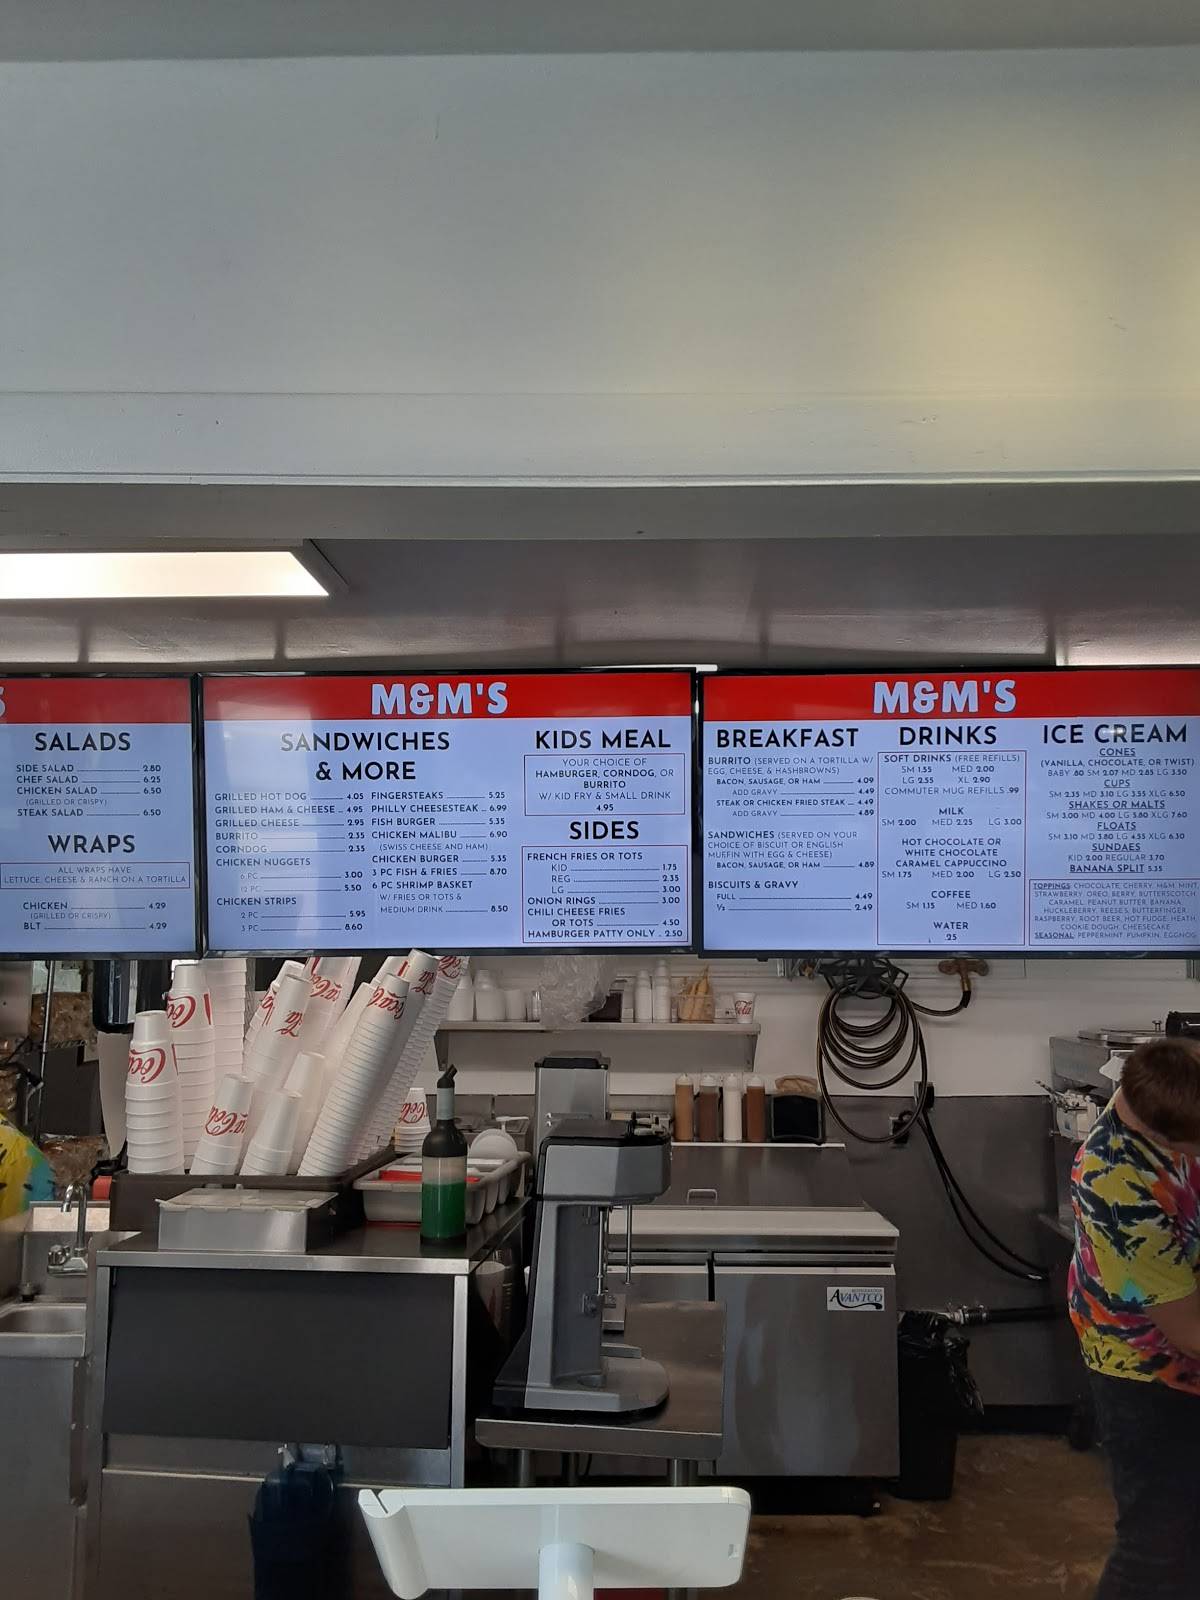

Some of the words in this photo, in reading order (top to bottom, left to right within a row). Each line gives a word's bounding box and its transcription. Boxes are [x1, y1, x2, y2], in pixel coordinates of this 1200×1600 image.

[371, 682, 508, 715] M&M'S
[873, 680, 1017, 714] M&M'S
[717, 728, 859, 748] BREAKFAST
[899, 726, 997, 745] DRINKS
[1043, 724, 1084, 744] ICE
[1094, 724, 1187, 743] CREAM
[34, 732, 131, 751] SALADS
[280, 732, 450, 752] SANDWICHES
[536, 730, 592, 749] KIDS
[602, 729, 671, 748] MEAL
[1099, 748, 1136, 756] CONES
[563, 758, 590, 767] YOUR
[592, 758, 630, 766] CHOICE
[633, 758, 647, 766] OF
[884, 755, 910, 763] SOFT
[16, 764, 38, 773] SIDE
[42, 764, 74, 773] SALAD
[315, 761, 332, 781] &
[342, 761, 416, 781] MORE
[660, 769, 674, 777] OR
[16, 776, 43, 784] CHEF
[46, 776, 79, 784] SALAD
[143, 776, 161, 784] 6.25
[16, 787, 62, 795] CHICKEN
[66, 787, 98, 795] SALAD
[143, 787, 162, 795] 6.50
[214, 793, 257, 801] GRILLED
[260, 793, 281, 801] HOT
[596, 804, 614, 812] 4.95
[1068, 801, 1109, 809] SHAKES
[1112, 801, 1127, 809] OR
[1131, 800, 1166, 808] MALTS
[371, 805, 407, 813] PHILLY
[939, 807, 965, 815] MILK
[261, 819, 299, 827] CHEESE
[371, 818, 393, 826] FISH
[1097, 822, 1136, 830] FLOATS
[569, 821, 639, 840] SIDES
[371, 831, 416, 839] CHICKEN
[708, 831, 775, 839] SANDWICHES
[48, 834, 136, 853] WRAPS
[901, 838, 922, 846] HOT
[1092, 843, 1141, 851] SUNDAES
[372, 855, 416, 863] CHICKEN
[420, 855, 459, 863] BURGER
[527, 853, 567, 861] FRENCH
[570, 852, 597, 860] FRIES
[601, 852, 615, 860] OR
[618, 852, 643, 860] TOTS
[420, 868, 427, 876] &
[431, 868, 458, 876] FRIES
[551, 864, 567, 872] KID
[1117, 864, 1144, 872] SPLIT
[372, 881, 378, 889] 6
[381, 881, 393, 889] PC
[396, 881, 433, 889] SHRIMP
[708, 881, 751, 889] BISCUITS
[754, 881, 761, 889] &
[764, 881, 799, 889] GRAVY
[931, 891, 971, 899] COFFEE
[216, 898, 261, 906] CHICKEN
[527, 897, 563, 905] ONION
[22, 902, 68, 910] CHICKEN
[148, 902, 166, 910] 4.29
[527, 908, 554, 916] CHILI
[557, 908, 595, 916] CHEESE
[599, 908, 626, 916] FRIES
[23, 922, 41, 930] BLT
[149, 922, 167, 930] 4.29
[552, 919, 566, 927] OR
[570, 919, 594, 927] TOTS
[829, 1289, 883, 1309] AVANTCO
